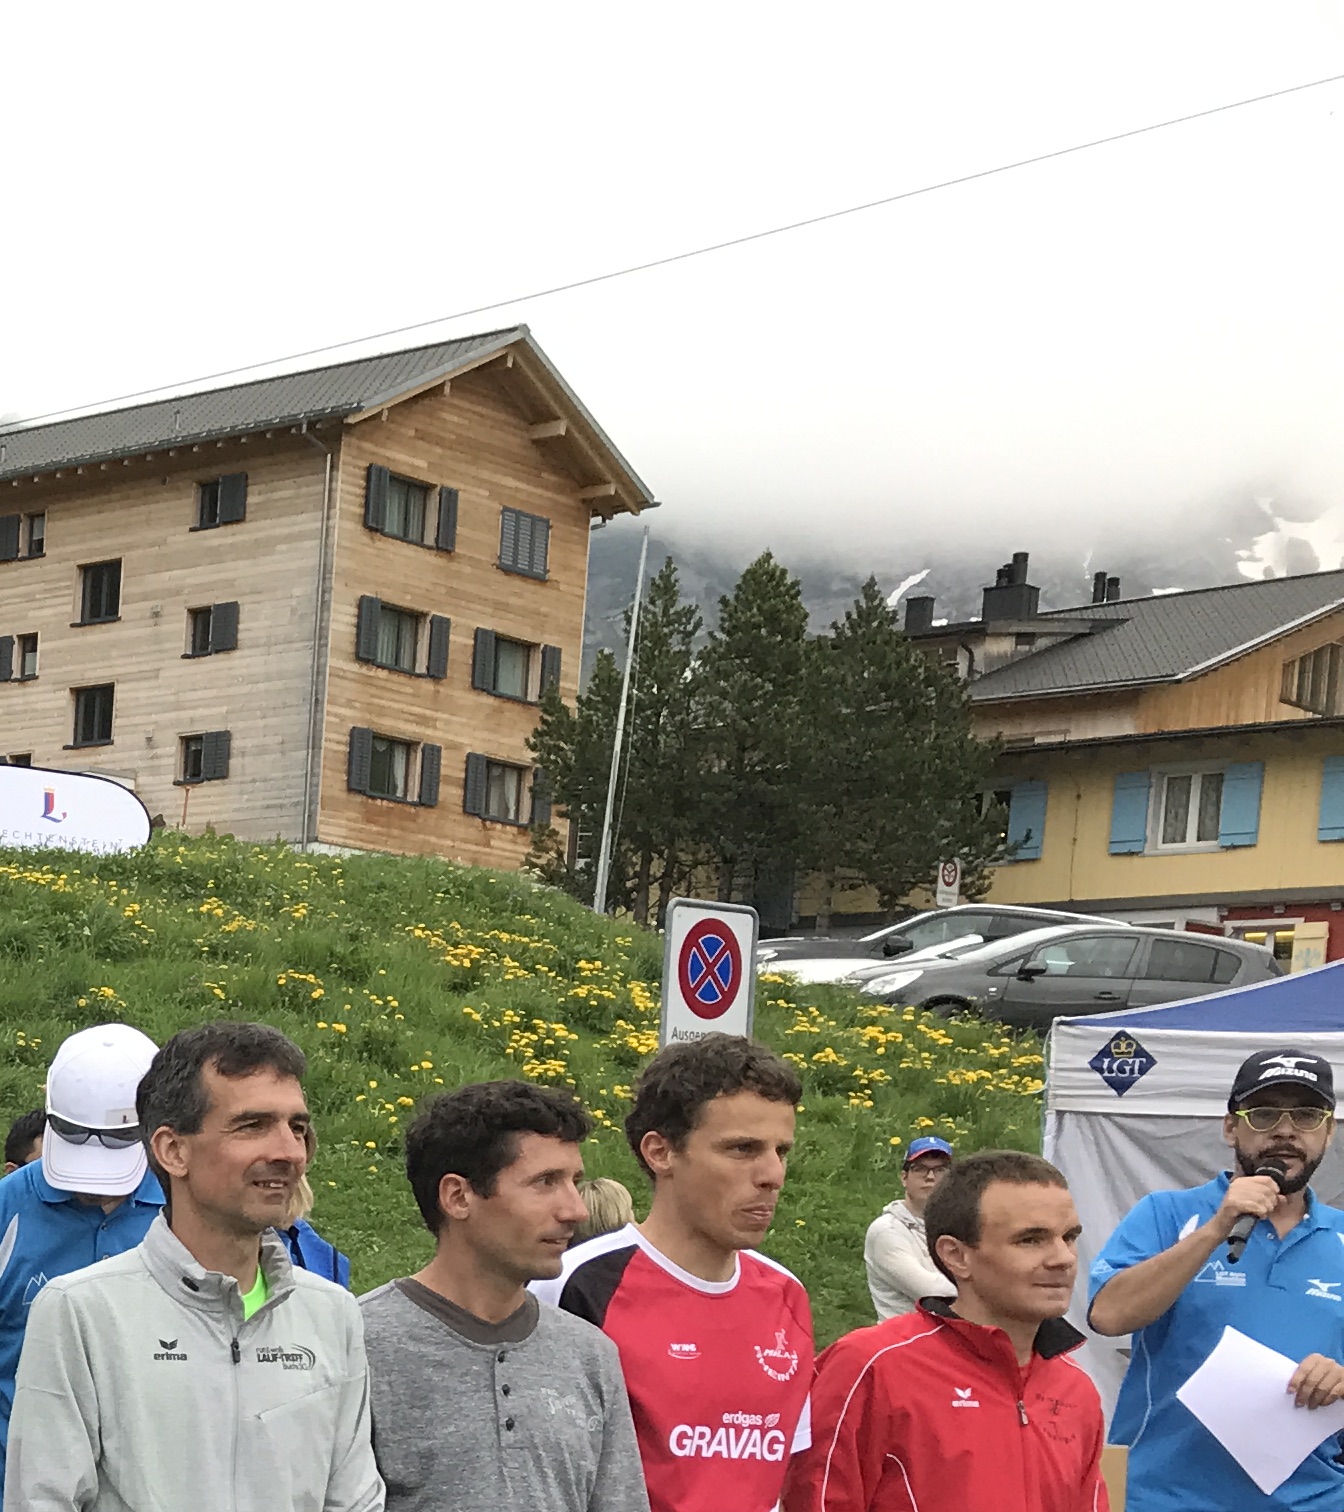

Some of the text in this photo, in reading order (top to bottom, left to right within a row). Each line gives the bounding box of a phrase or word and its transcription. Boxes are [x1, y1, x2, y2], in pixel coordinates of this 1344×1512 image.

[1102, 1057, 1146, 1077] LGT
[153, 1351, 188, 1361] erima
[722, 1411, 763, 1427] erdgas
[669, 1424, 786, 1461] GRAVAG
